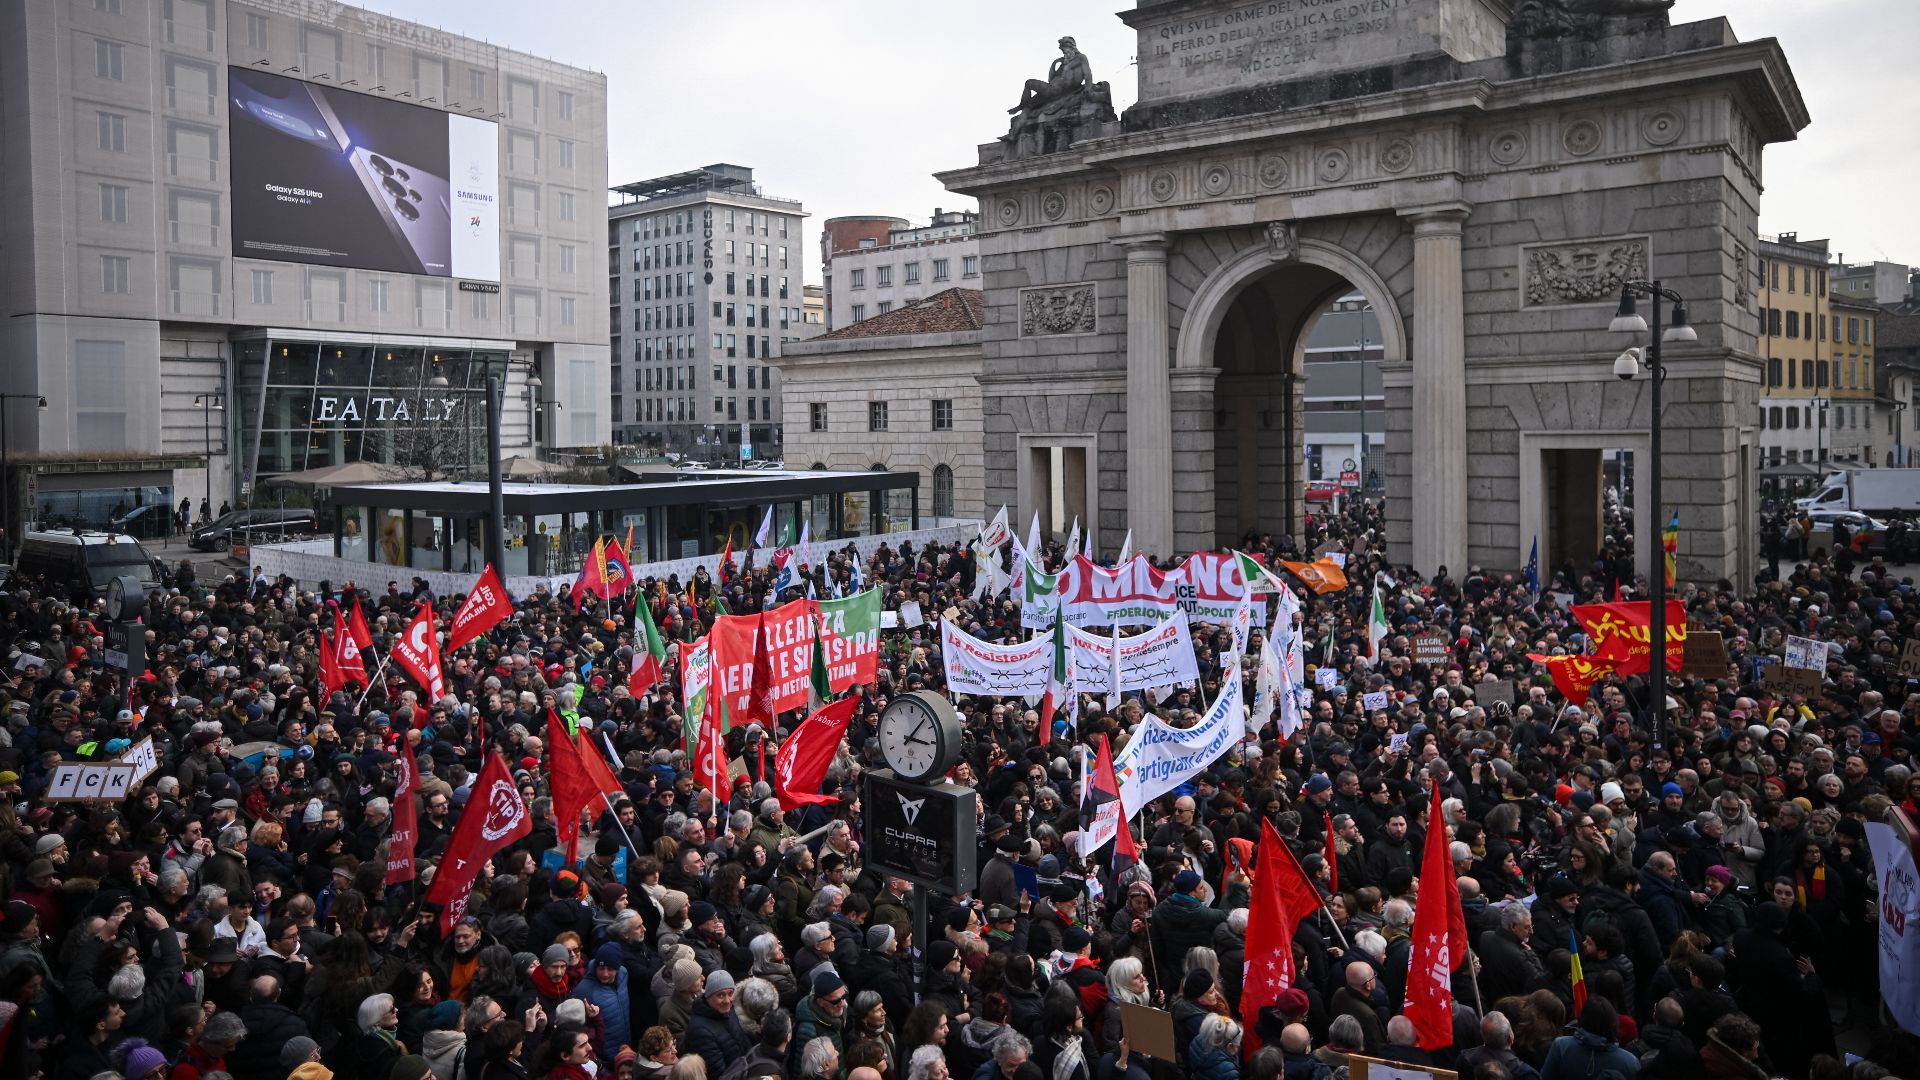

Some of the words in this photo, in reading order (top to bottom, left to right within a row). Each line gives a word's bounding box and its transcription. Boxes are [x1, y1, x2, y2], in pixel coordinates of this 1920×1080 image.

[366, 17, 452, 49] SMERALDO
[1172, 35, 1215, 52] FERRO
[265, 184, 292, 195] Galaxy
[306, 190, 323, 198] Ultra
[457, 190, 493, 202] SAMSUNG
[277, 194, 299, 204] Galaxy
[1175, 585, 1195, 598] ICE
[1177, 600, 1197, 613] OUT
[398, 641, 420, 665] FISAC
[1764, 680, 1815, 695] FASCISM
[885, 826, 937, 849] CUPRA
[885, 837, 937, 859] GARAGE
